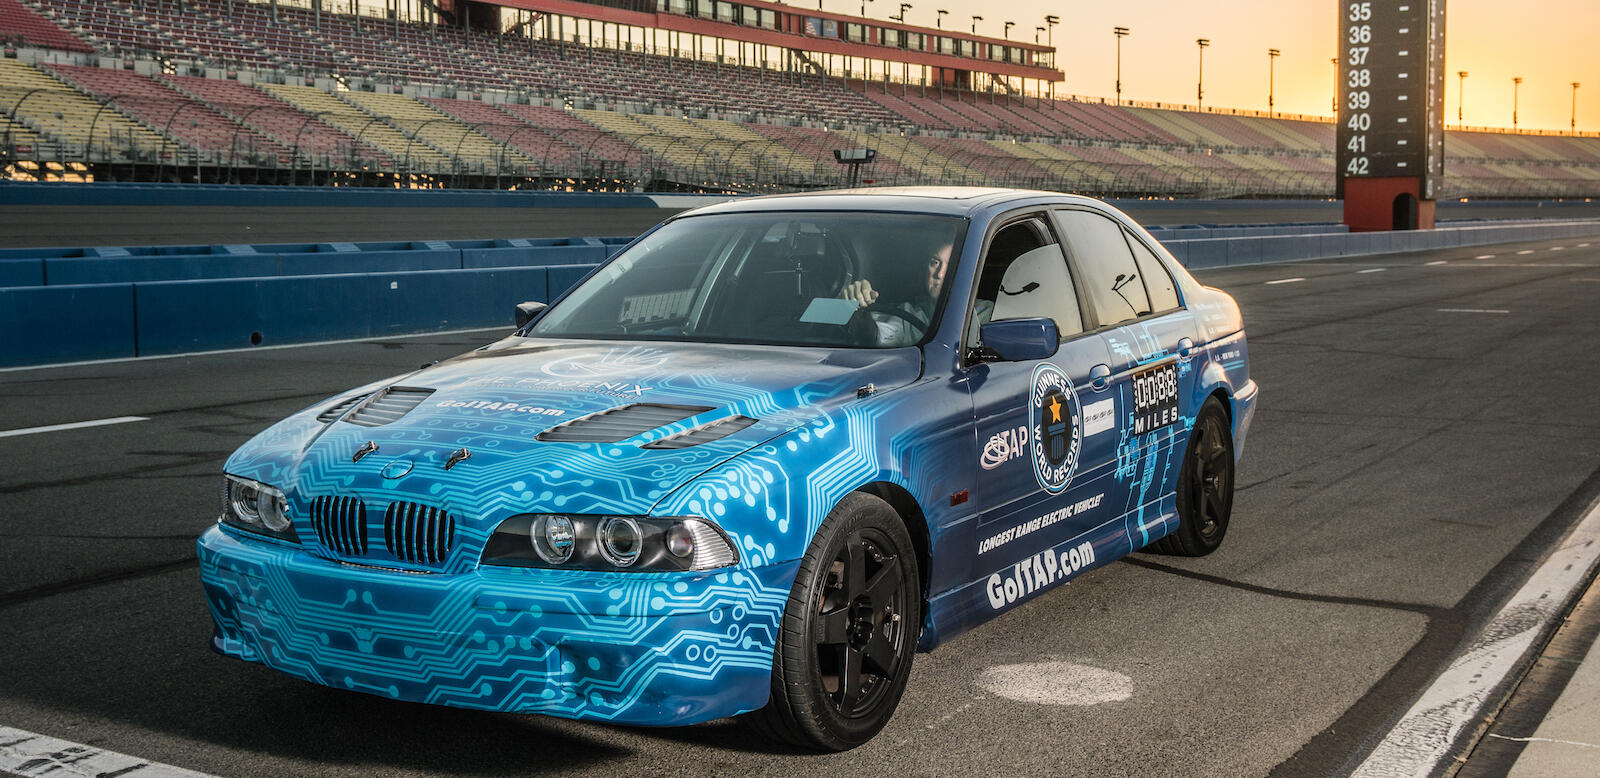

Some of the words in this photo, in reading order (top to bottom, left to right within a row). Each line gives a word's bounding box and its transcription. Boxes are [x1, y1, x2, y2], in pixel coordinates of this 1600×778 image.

[1349, 2, 1371, 21] 35
[1349, 25, 1371, 44] 36
[1349, 47, 1369, 65] 37
[1349, 69, 1371, 87] 38
[1348, 91, 1370, 109] 39
[1348, 113, 1371, 131] 40
[1347, 135, 1366, 152] 41
[1347, 157, 1369, 175] 42
[514, 378, 653, 397] PHOENIX
[1034, 373, 1072, 408] GUINNESS
[1137, 369, 1176, 408] 0088
[435, 400, 566, 417] GoITAP.com
[1134, 406, 1178, 435] MILES
[1034, 424, 1053, 481] WORLD
[1053, 415, 1079, 483] RECORDS
[978, 527, 1017, 555] LONGEST
[1015, 516, 1042, 538] RANGE
[1041, 505, 1075, 528] ELECTRIC
[986, 541, 1095, 609] GoITAP.com
